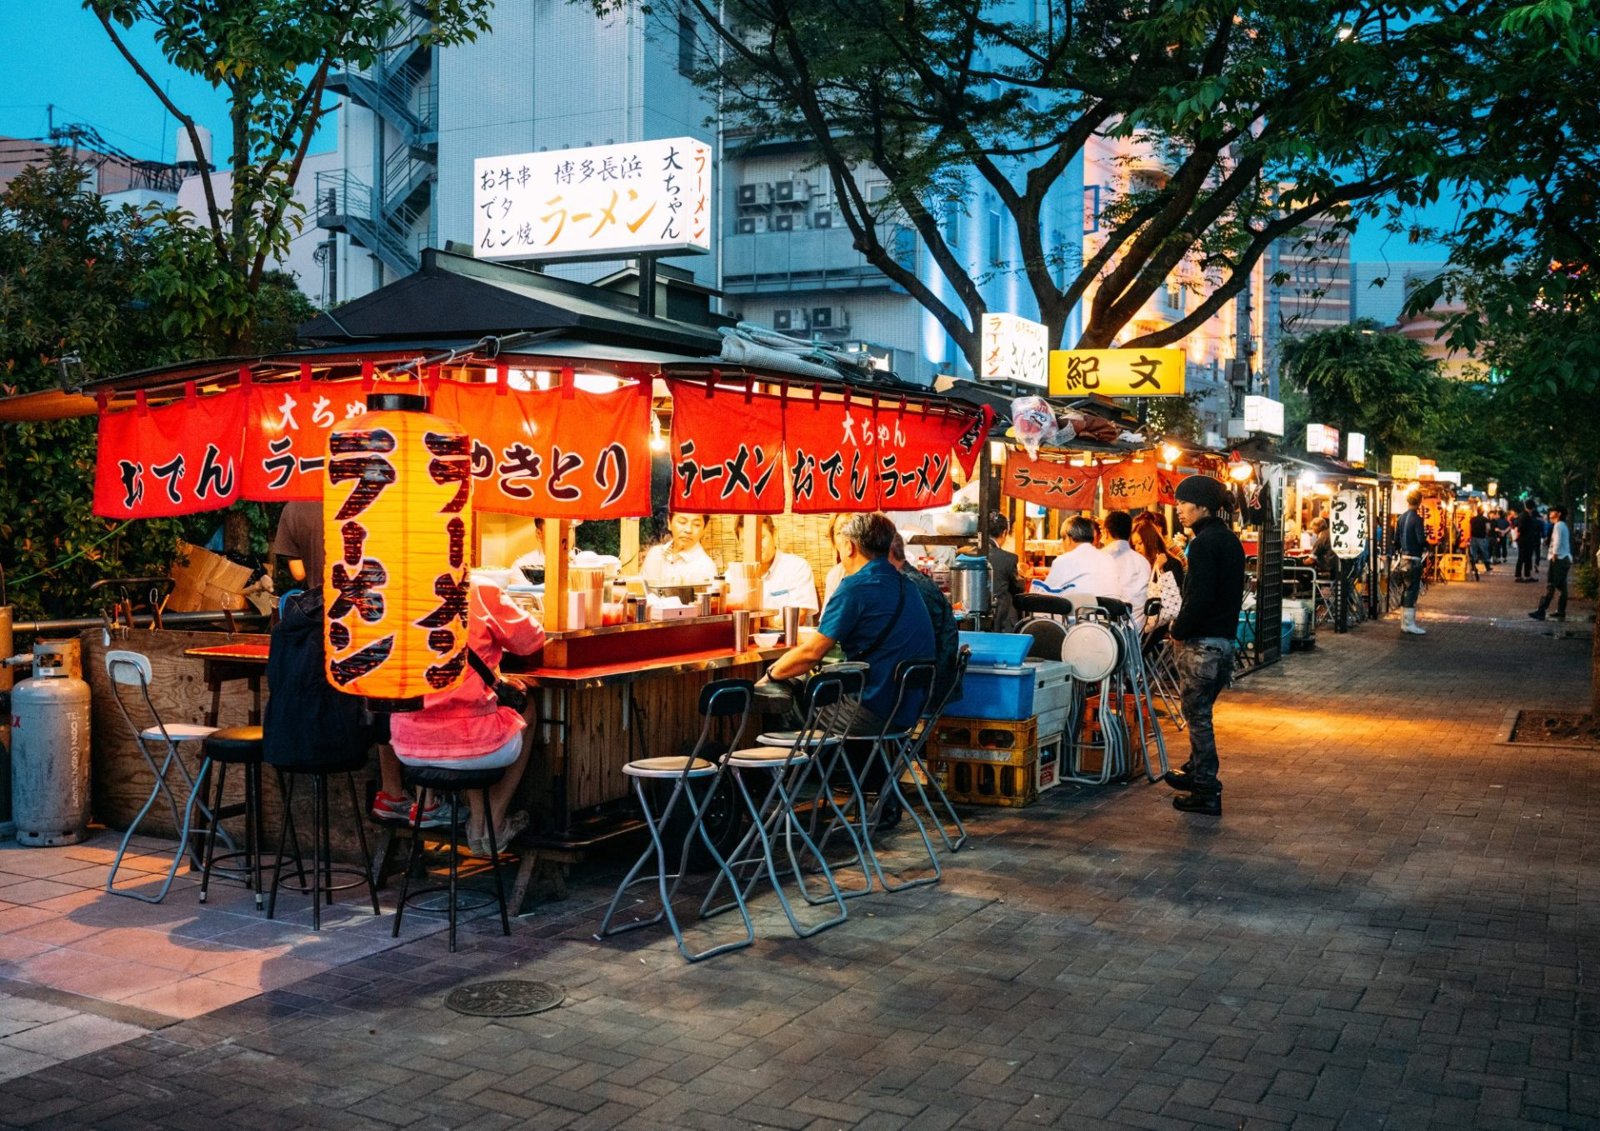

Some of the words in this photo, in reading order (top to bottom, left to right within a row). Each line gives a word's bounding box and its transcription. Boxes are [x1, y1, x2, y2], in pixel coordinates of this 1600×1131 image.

[554, 154, 643, 185] 博多長浜
[661, 146, 683, 240] 大ちゃん
[694, 148, 705, 239] ラーメン
[480, 168, 498, 249] おでん
[498, 167, 515, 247] 牛タン
[516, 165, 535, 246] 串焼
[540, 188, 657, 246] ラーメン
[986, 317, 1002, 376] ラーメン
[1066, 355, 1163, 390] 紀文
[841, 410, 906, 448] 大ちゃん
[118, 443, 235, 510] おでん
[677, 439, 783, 500] ラーメン
[791, 448, 870, 502] おでん
[880, 452, 950, 499] ラーメン
[1014, 468, 1087, 497] ラーメン
[1109, 476, 1155, 497] 焼ラーメン
[328, 428, 397, 686] ラーメン
[413, 431, 472, 690] ラーメン
